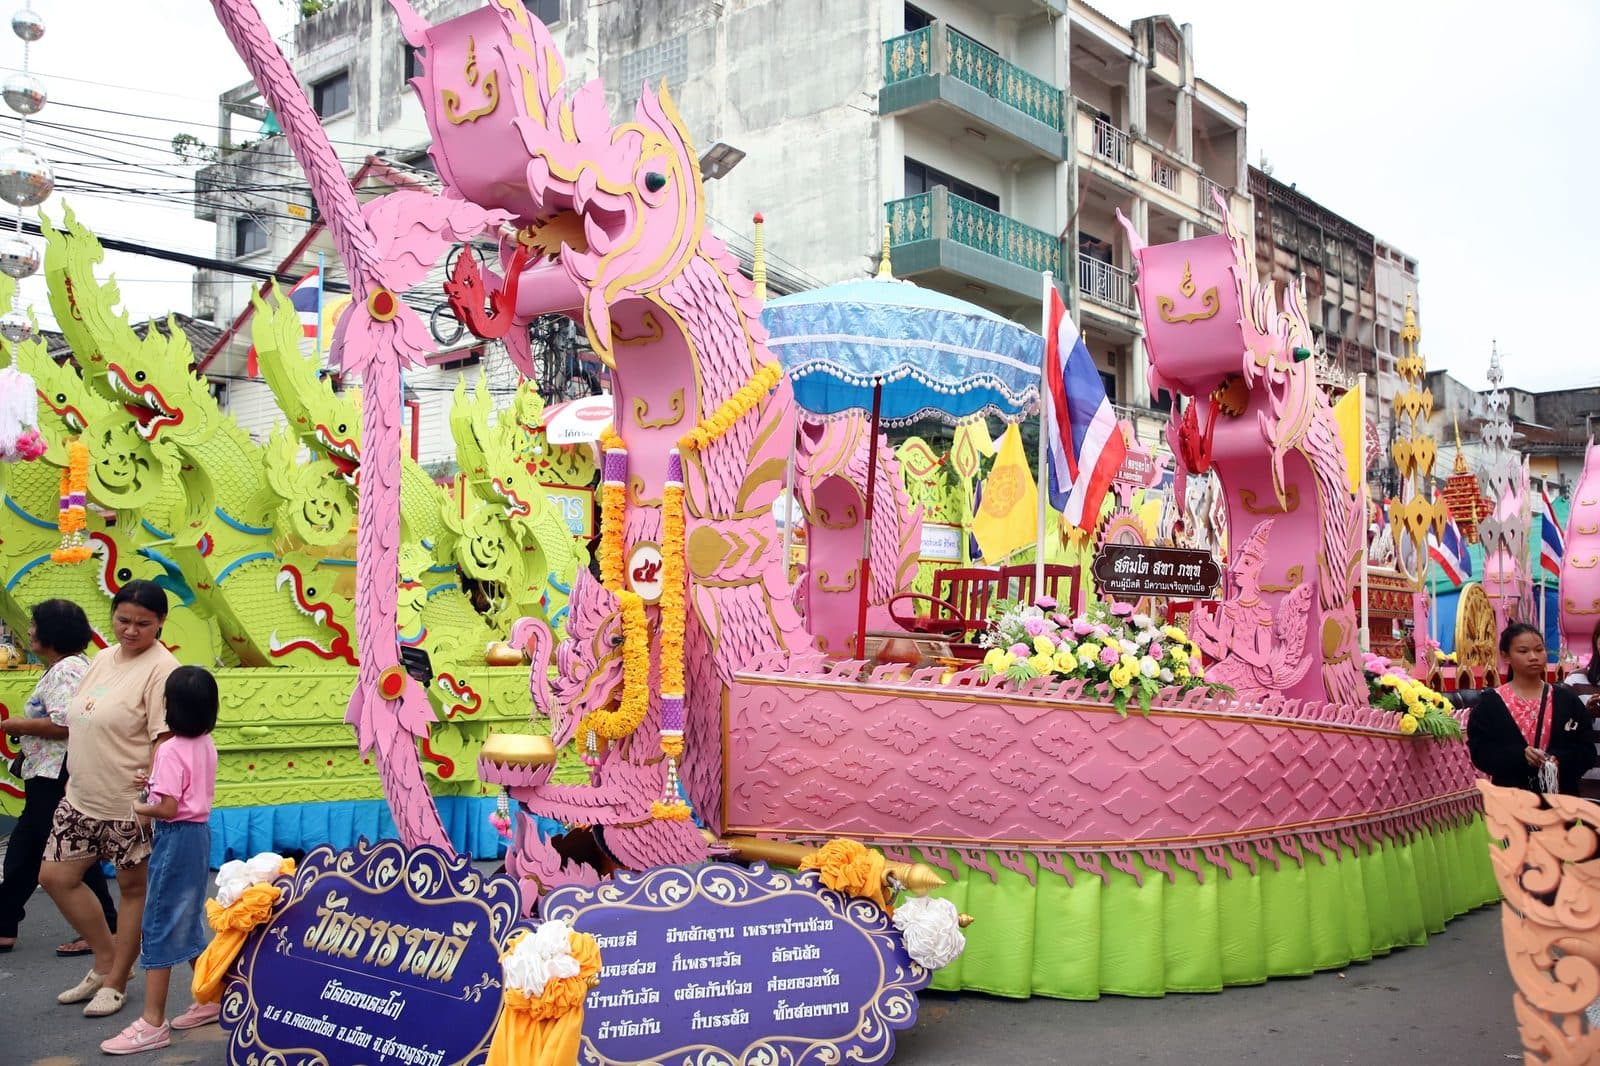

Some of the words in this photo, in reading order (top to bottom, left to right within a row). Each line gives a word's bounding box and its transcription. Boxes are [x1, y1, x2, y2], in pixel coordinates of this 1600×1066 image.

[302, 889, 477, 983] วัดธาราวดี
[592, 930, 637, 949] ัดจะดี
[666, 925, 734, 943] มีหลักฐาน
[743, 916, 833, 937] เพราะบ้านช่วย
[672, 950, 741, 971] ก็เพราะวัด
[771, 944, 820, 963] ดัดนิสัย
[587, 987, 660, 1009] บ้านกับวัด
[674, 979, 752, 1001] ผลัดกันช่วย
[598, 1017, 661, 1039] ถ้าขัดกัน
[691, 1008, 749, 1030] ก็บรรลัย
[773, 999, 849, 1021] ทั้งสองทาง
